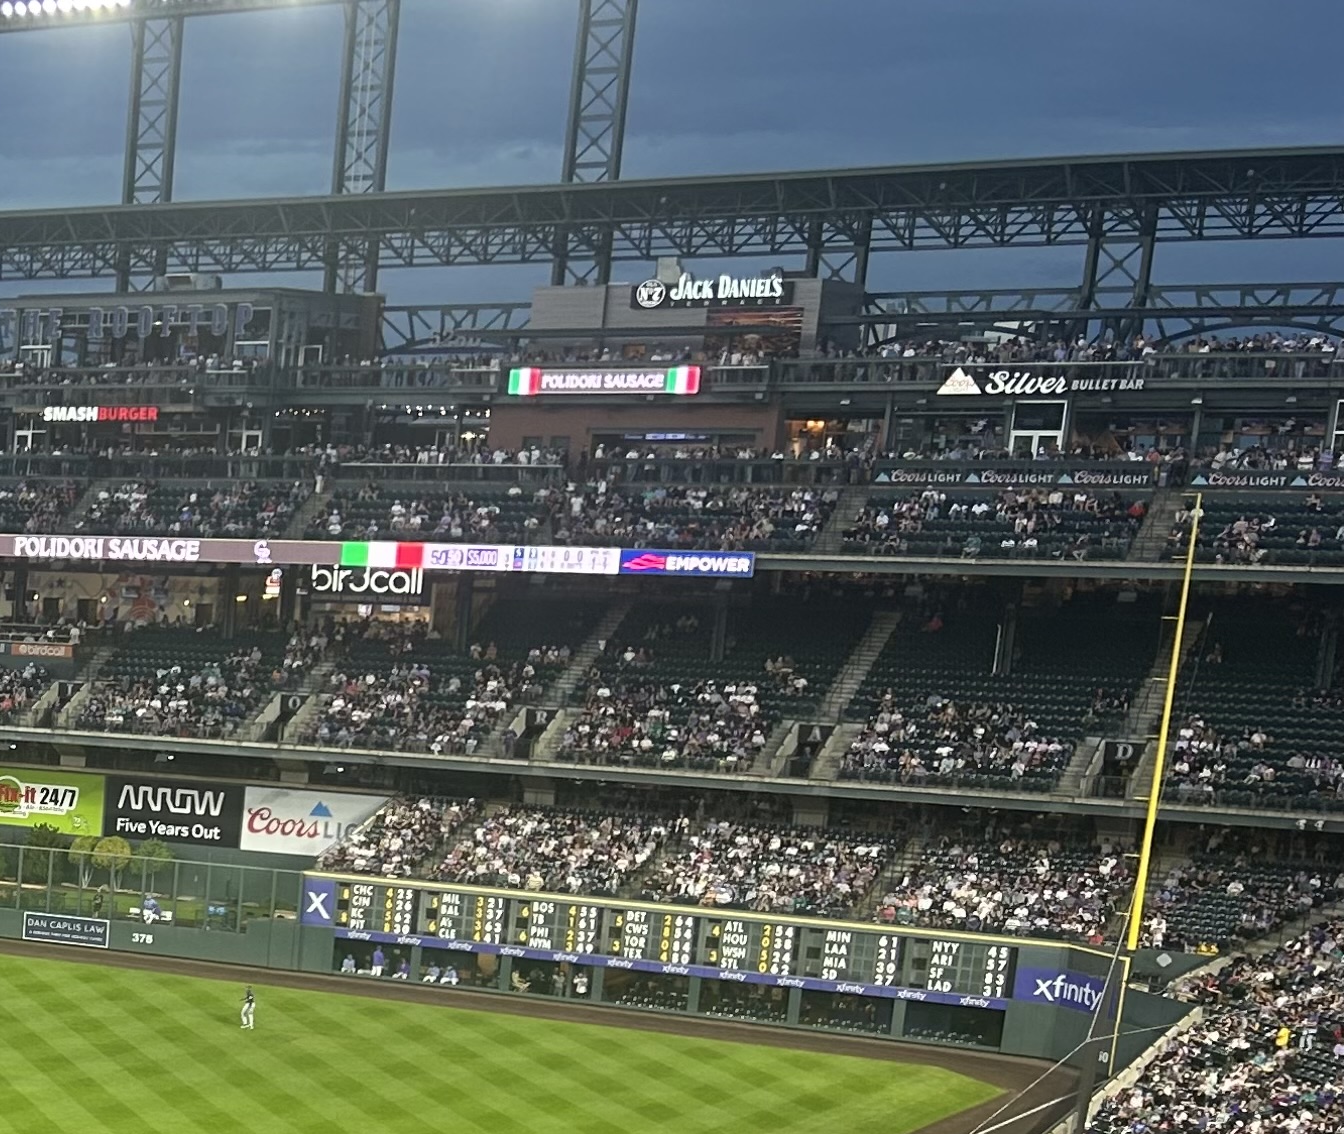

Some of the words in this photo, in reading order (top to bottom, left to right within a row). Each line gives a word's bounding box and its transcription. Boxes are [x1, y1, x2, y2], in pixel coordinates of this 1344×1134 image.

[669, 273, 714, 300] JACK
[717, 274, 783, 298] DANIEL'S
[540, 374, 602, 389] POLIDORI
[603, 374, 665, 389] SAUSAGE
[985, 371, 1068, 395] Silver
[1070, 379, 1118, 391] BULLET
[1118, 378, 1145, 390] BAR
[43, 406, 159, 422] SMASHBURGER
[1019, 472, 1054, 483] LIGHT
[1113, 473, 1150, 485] LIGHT
[13, 536, 105, 559] POLIDORI
[108, 539, 200, 561] SAUSAGE
[664, 556, 750, 573] EMPOWER
[311, 564, 424, 595] birdcall
[40, 786, 76, 808] 24/7
[116, 817, 148, 835] Five
[149, 820, 190, 838] Years
[191, 823, 221, 840] Out
[247, 807, 320, 839] Coors
[353, 885, 373, 896] CHC
[352, 896, 371, 907] CIN
[442, 893, 460, 905] MIL
[351, 908, 365, 919] KC
[441, 905, 459, 916] BAL
[532, 902, 555, 914] BOS
[440, 917, 453, 928] A's
[532, 913, 545, 925] TB
[626, 911, 647, 922] DET
[27, 918, 47, 928] DAN
[49, 921, 82, 932] CAPLIS
[84, 925, 105, 934] LAW
[350, 919, 366, 930] PIT
[625, 923, 649, 935] CWS
[724, 921, 744, 933] ATL
[438, 928, 456, 939] CLE
[530, 926, 549, 938] PHI
[826, 931, 852, 943] MIN
[529, 938, 552, 950] NYM
[624, 936, 646, 948] TOR
[722, 933, 748, 945] HOU
[623, 947, 643, 959] TEX
[722, 946, 746, 959] WSH
[824, 943, 848, 955] LAA
[932, 941, 960, 954] NYY
[720, 958, 738, 970] STL
[823, 956, 847, 969] MIA
[930, 954, 953, 966] ARI
[821, 968, 838, 980] SD
[929, 967, 944, 979] SF
[927, 979, 952, 993] LAD
[1033, 975, 1104, 1011] xfinity
